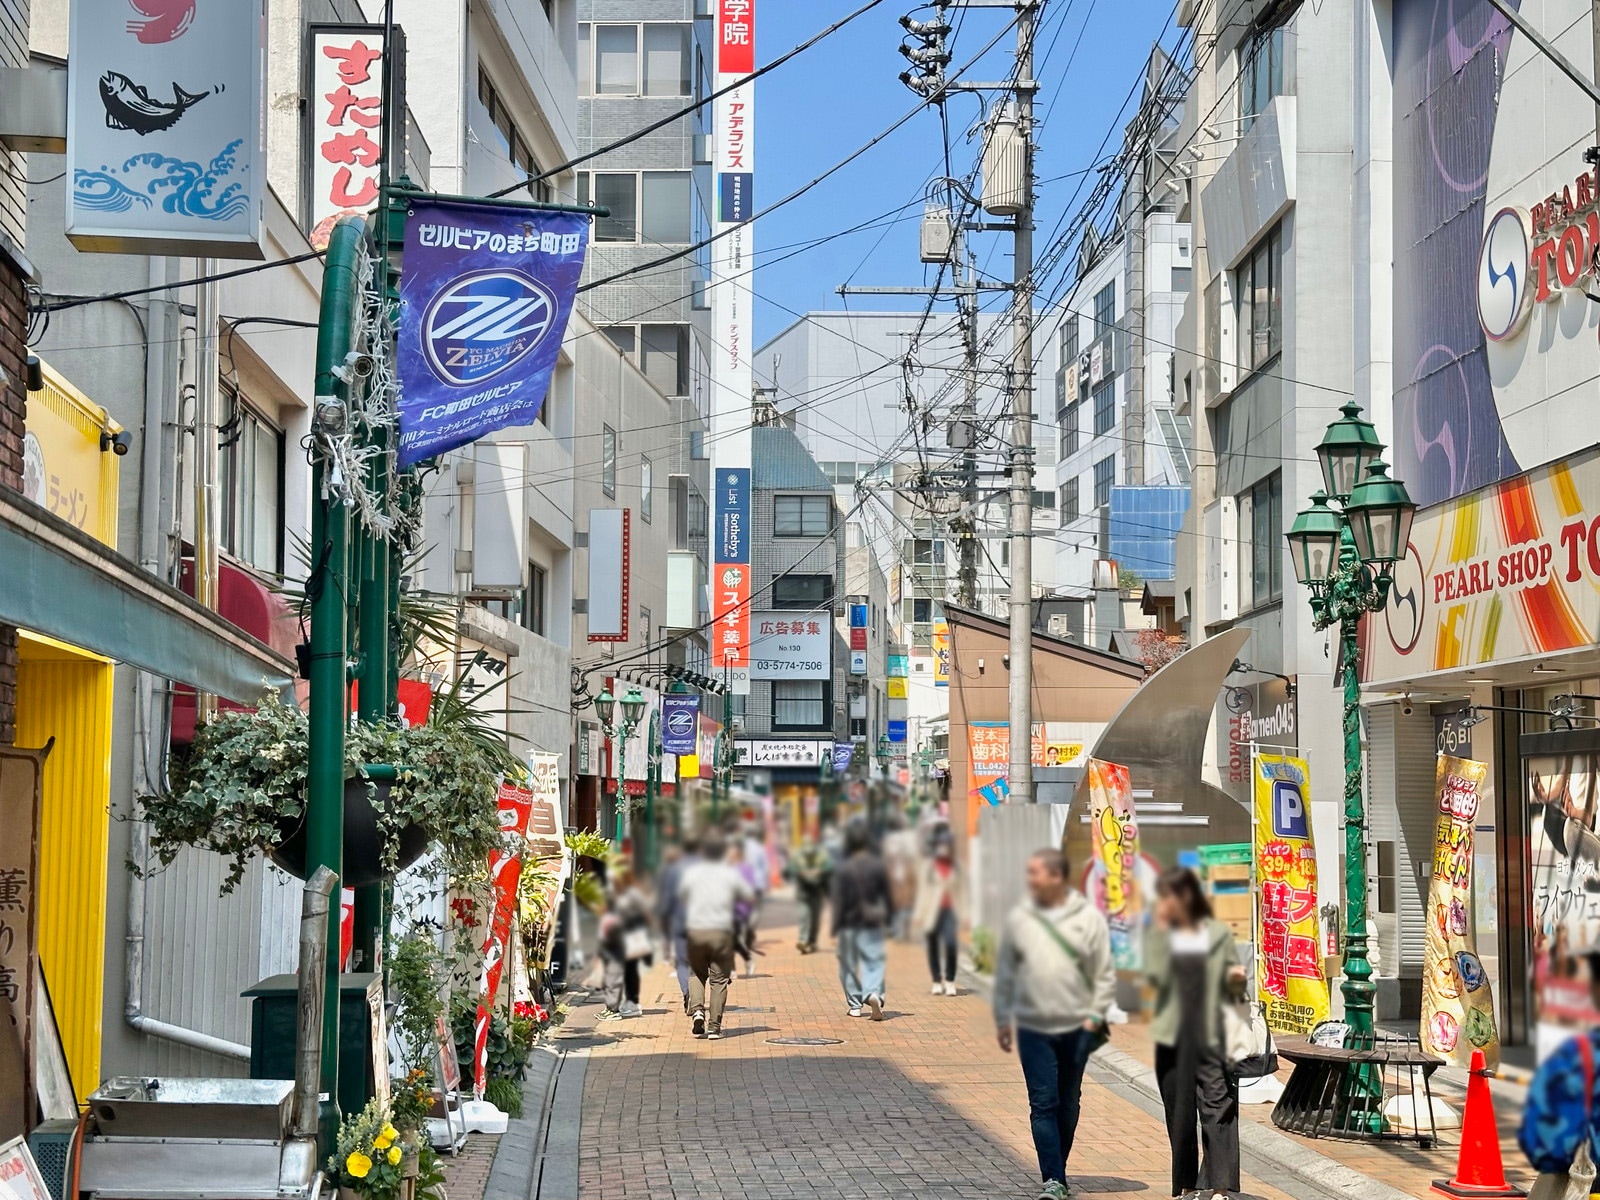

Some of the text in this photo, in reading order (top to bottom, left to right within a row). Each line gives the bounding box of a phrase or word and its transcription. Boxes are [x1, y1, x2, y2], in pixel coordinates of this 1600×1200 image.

[724, 0, 749, 45] 学院
[727, 103, 744, 168] アデランス
[419, 223, 581, 255] ゼルビアのまち町田
[445, 343, 525, 366] ZELVIA
[419, 381, 523, 422] FC町田ゼルビア
[728, 488, 738, 505] List
[728, 513, 740, 558] Sotheby's
[1434, 559, 1494, 604] PEARL
[1498, 543, 1552, 587] SHOP
[723, 592, 742, 662] スギ薬局
[760, 621, 821, 635] 広告募集
[757, 661, 823, 671] 03-5774-7506
[1229, 717, 1242, 782] TOMOE
[1280, 788, 1303, 829] P
[1264, 844, 1291, 855] バイク
[0, 869, 28, 1026] 薫り高
